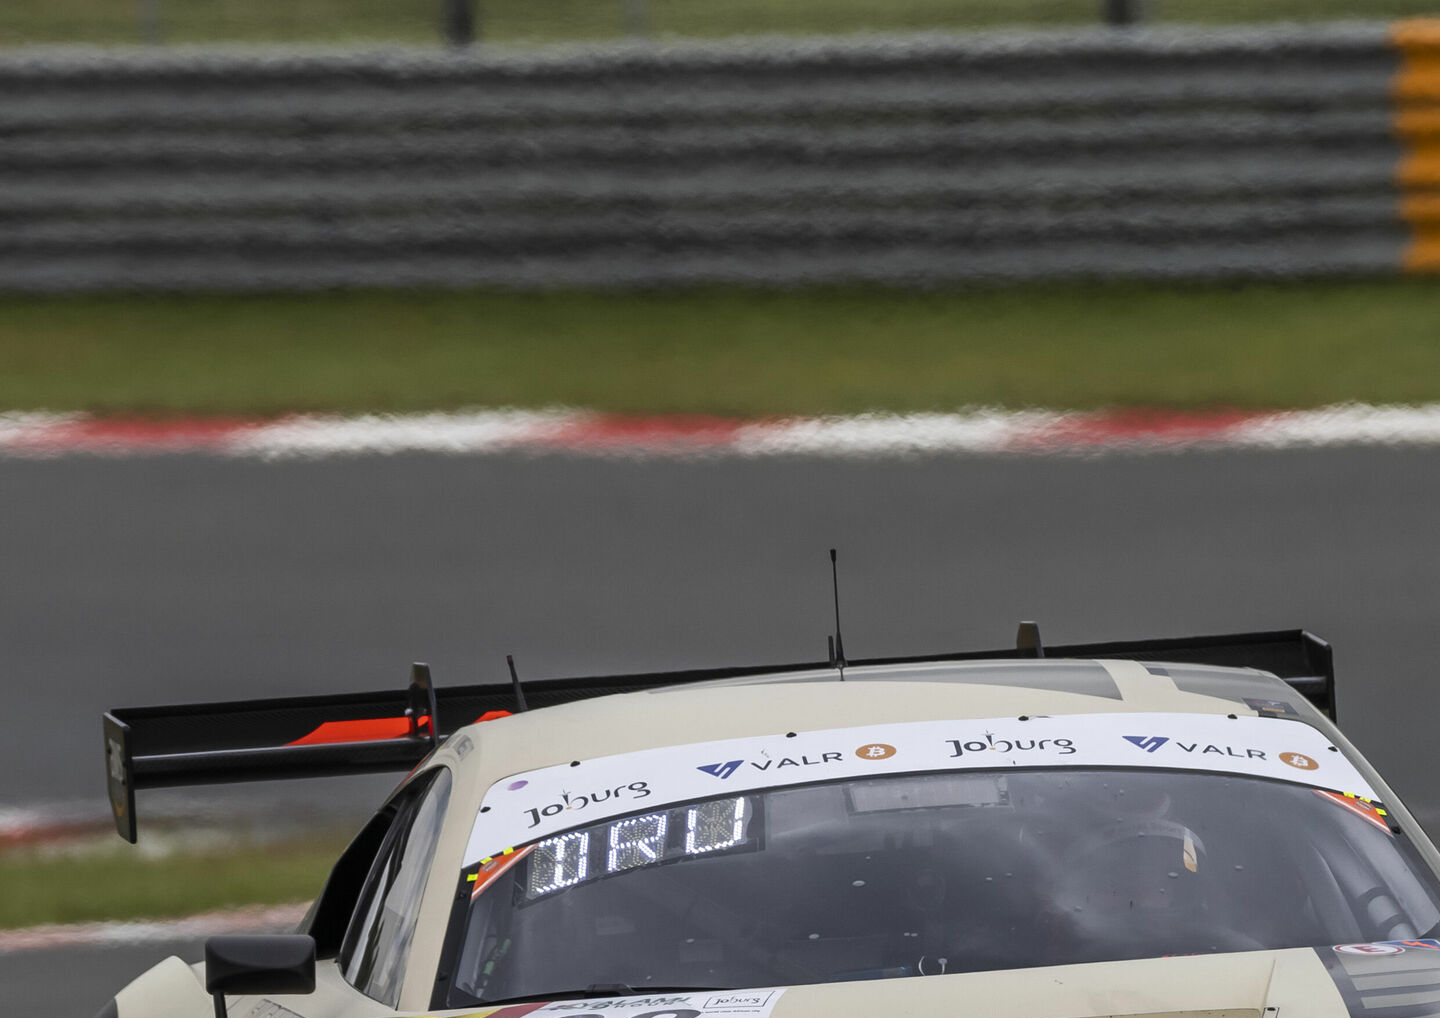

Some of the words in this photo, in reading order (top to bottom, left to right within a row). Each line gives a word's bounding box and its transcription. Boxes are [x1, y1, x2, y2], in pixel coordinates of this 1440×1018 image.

[946, 731, 1077, 757] Joburg
[1176, 742, 1267, 762] VALR
[750, 752, 843, 771] VALR
[524, 780, 651, 828] Joburg
